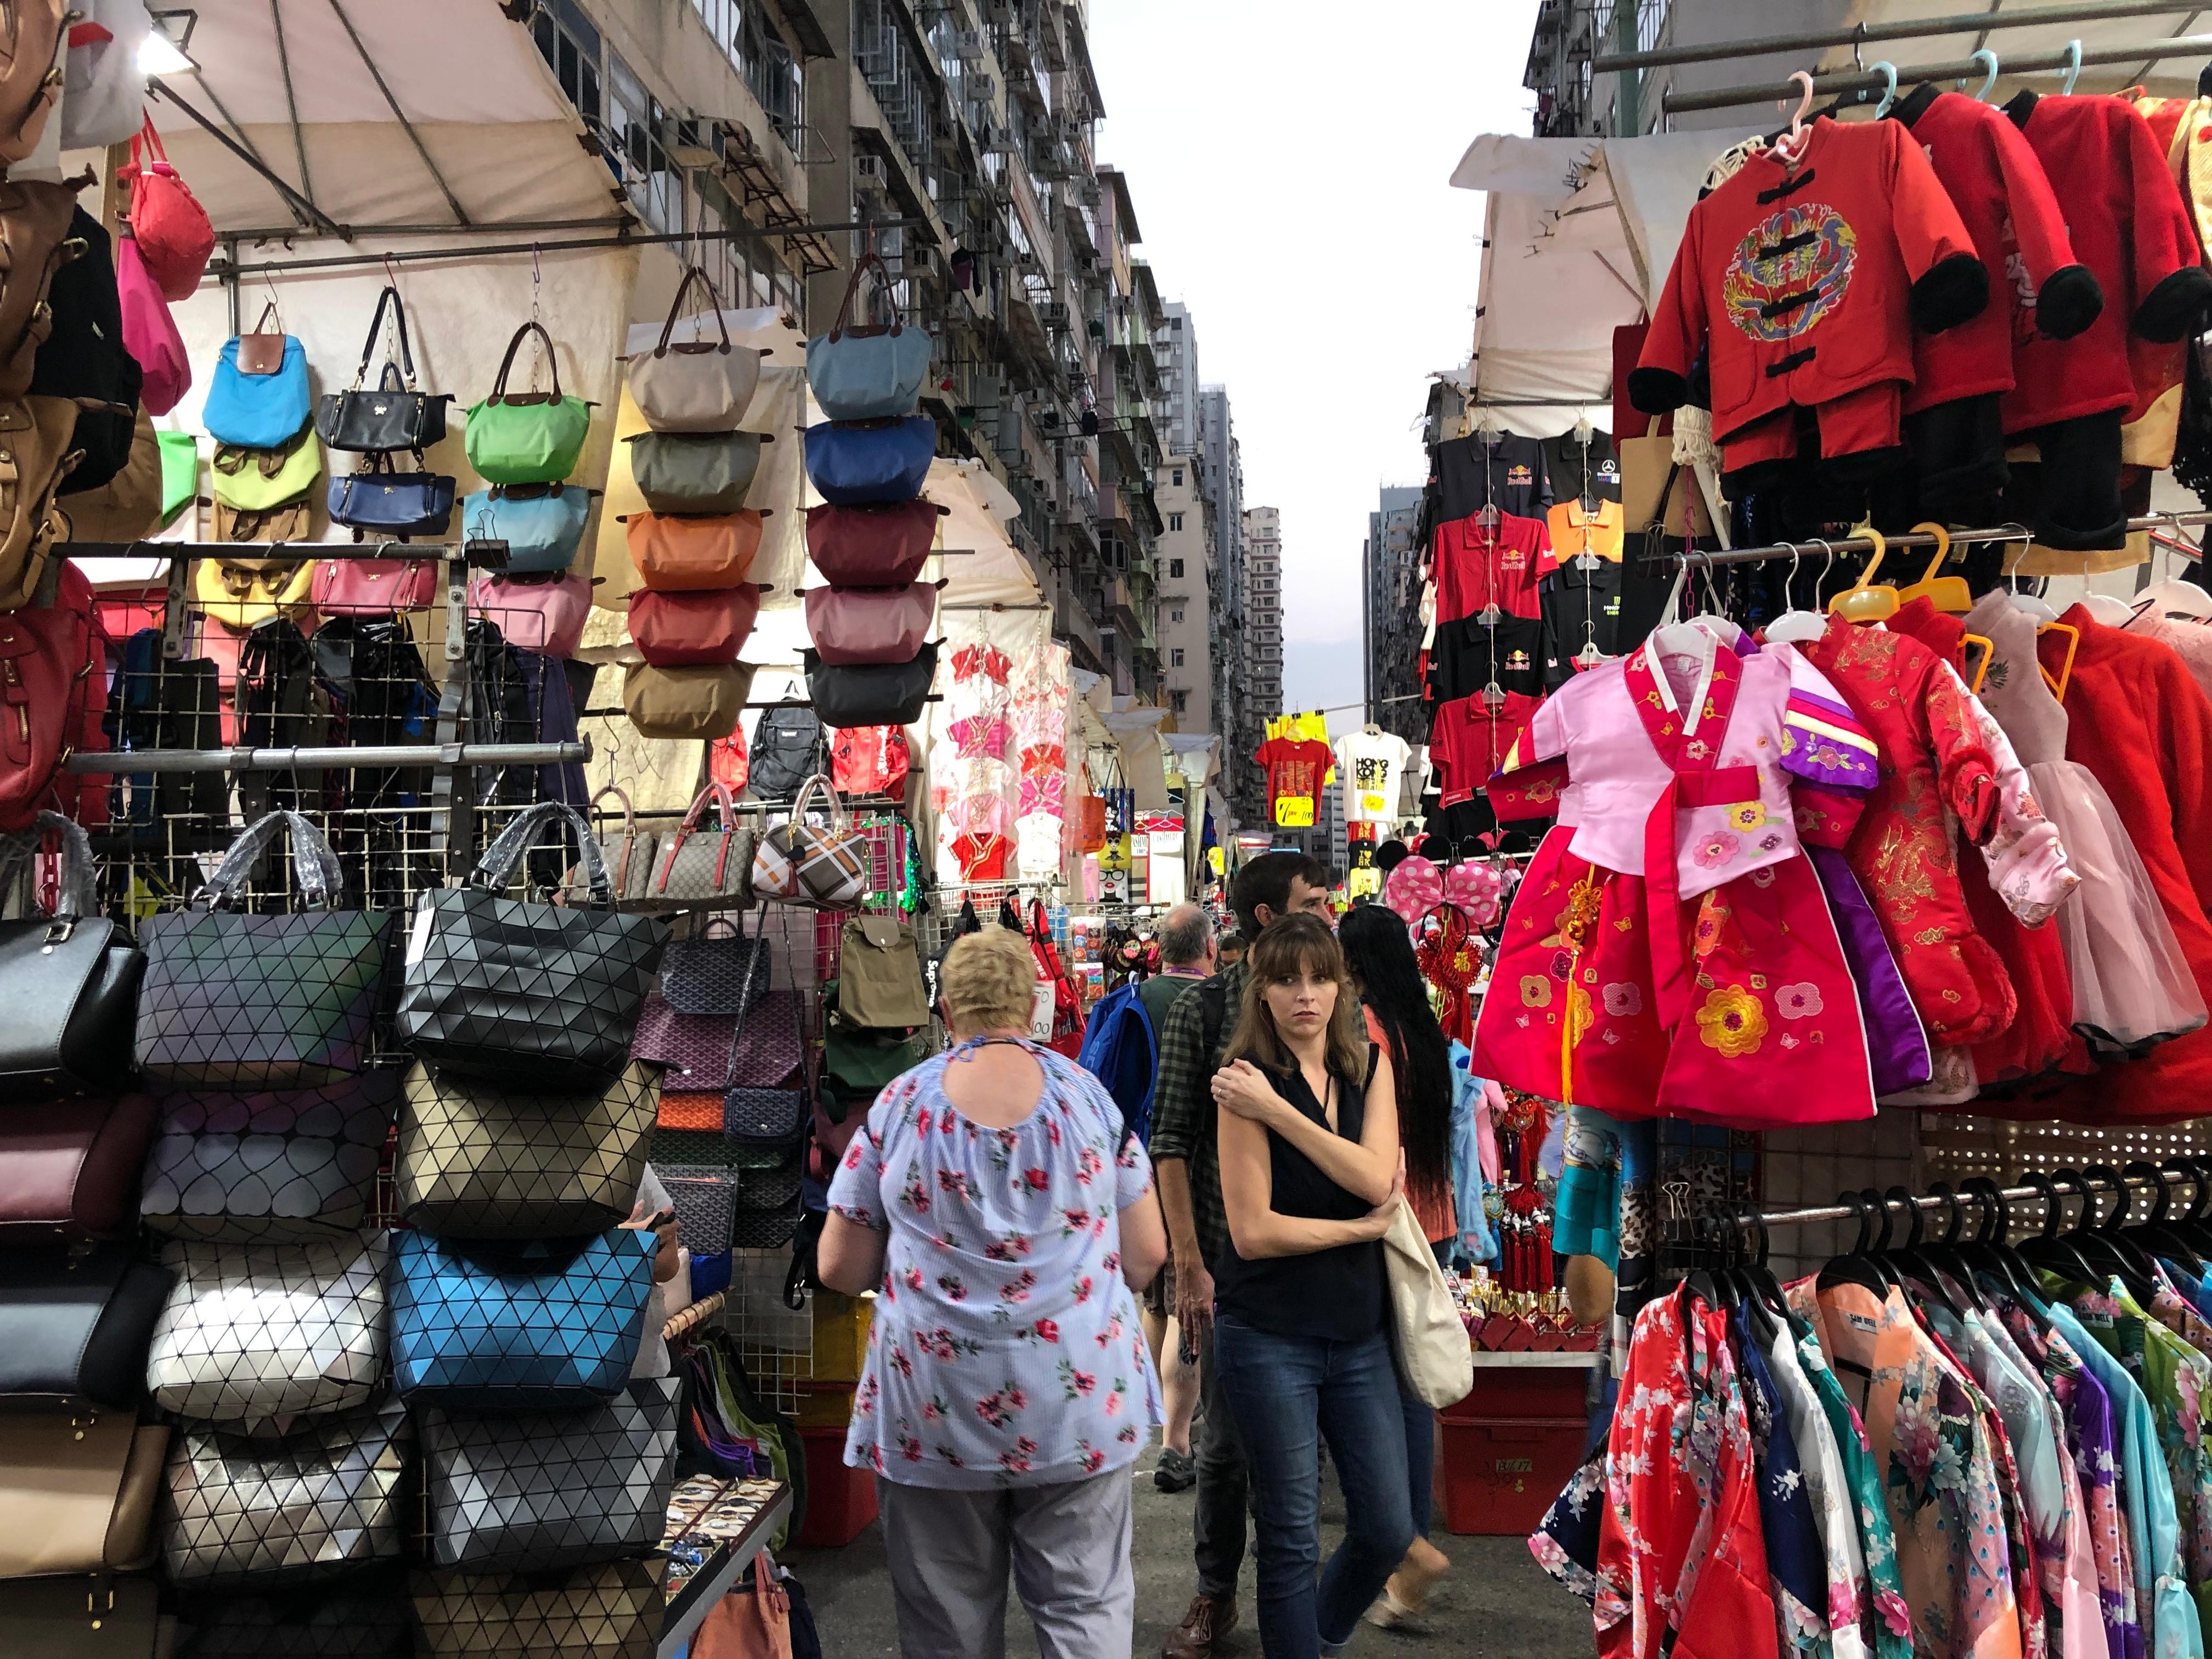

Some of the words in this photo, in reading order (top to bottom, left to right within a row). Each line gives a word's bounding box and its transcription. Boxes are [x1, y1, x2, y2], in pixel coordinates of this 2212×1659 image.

[1275, 760, 1317, 790] HK
[1356, 758, 1389, 769] HONG
[926, 960, 939, 1008] Supreme
